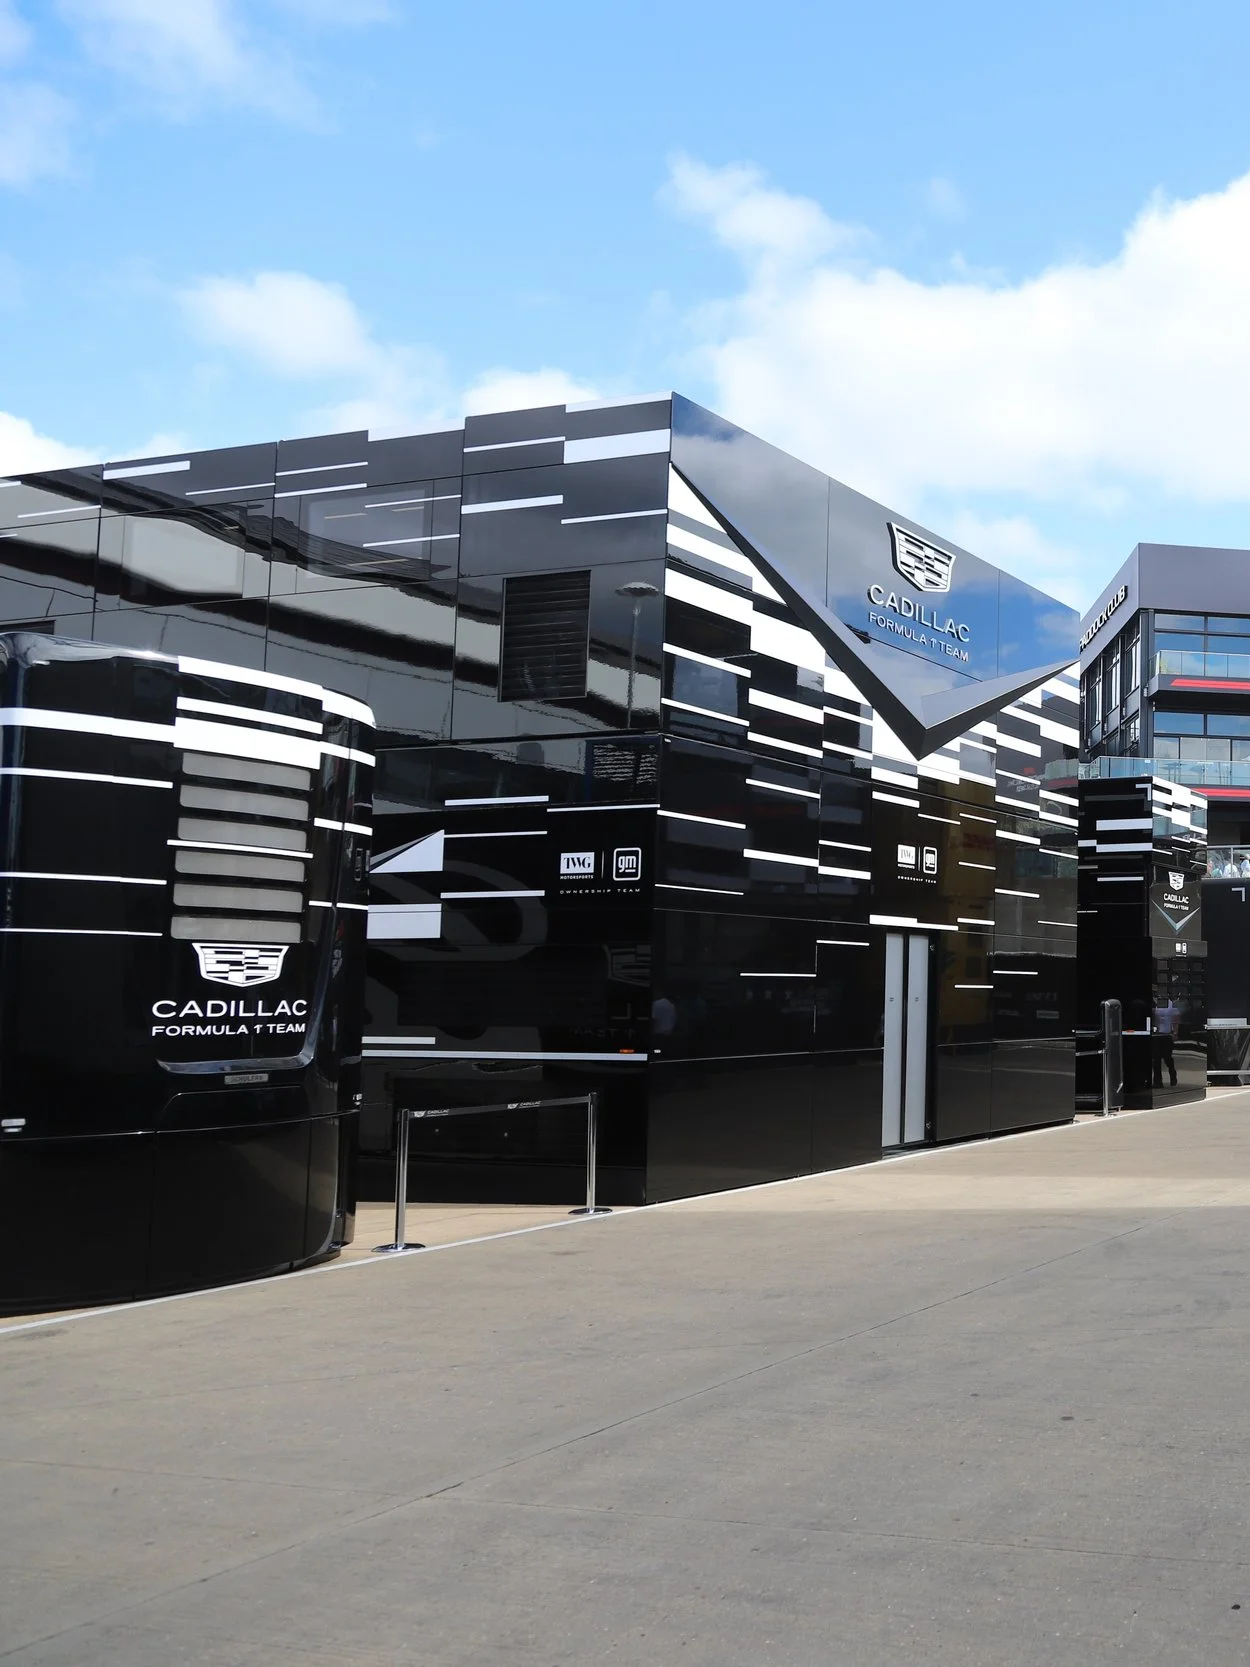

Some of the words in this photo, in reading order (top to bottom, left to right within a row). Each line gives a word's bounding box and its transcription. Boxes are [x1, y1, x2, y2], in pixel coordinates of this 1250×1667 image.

[1107, 585, 1126, 616] CLUB
[868, 584, 970, 642] CADILLAC
[869, 612, 927, 646] FORMULA
[939, 641, 969, 661] TEAM
[563, 856, 591, 869] TWG
[618, 856, 637, 873] gm
[1164, 893, 1189, 904] CADILLAC
[152, 1000, 307, 1018] CADILLAC
[151, 1025, 249, 1036] FORMULA
[267, 1023, 306, 1033] TEAM
